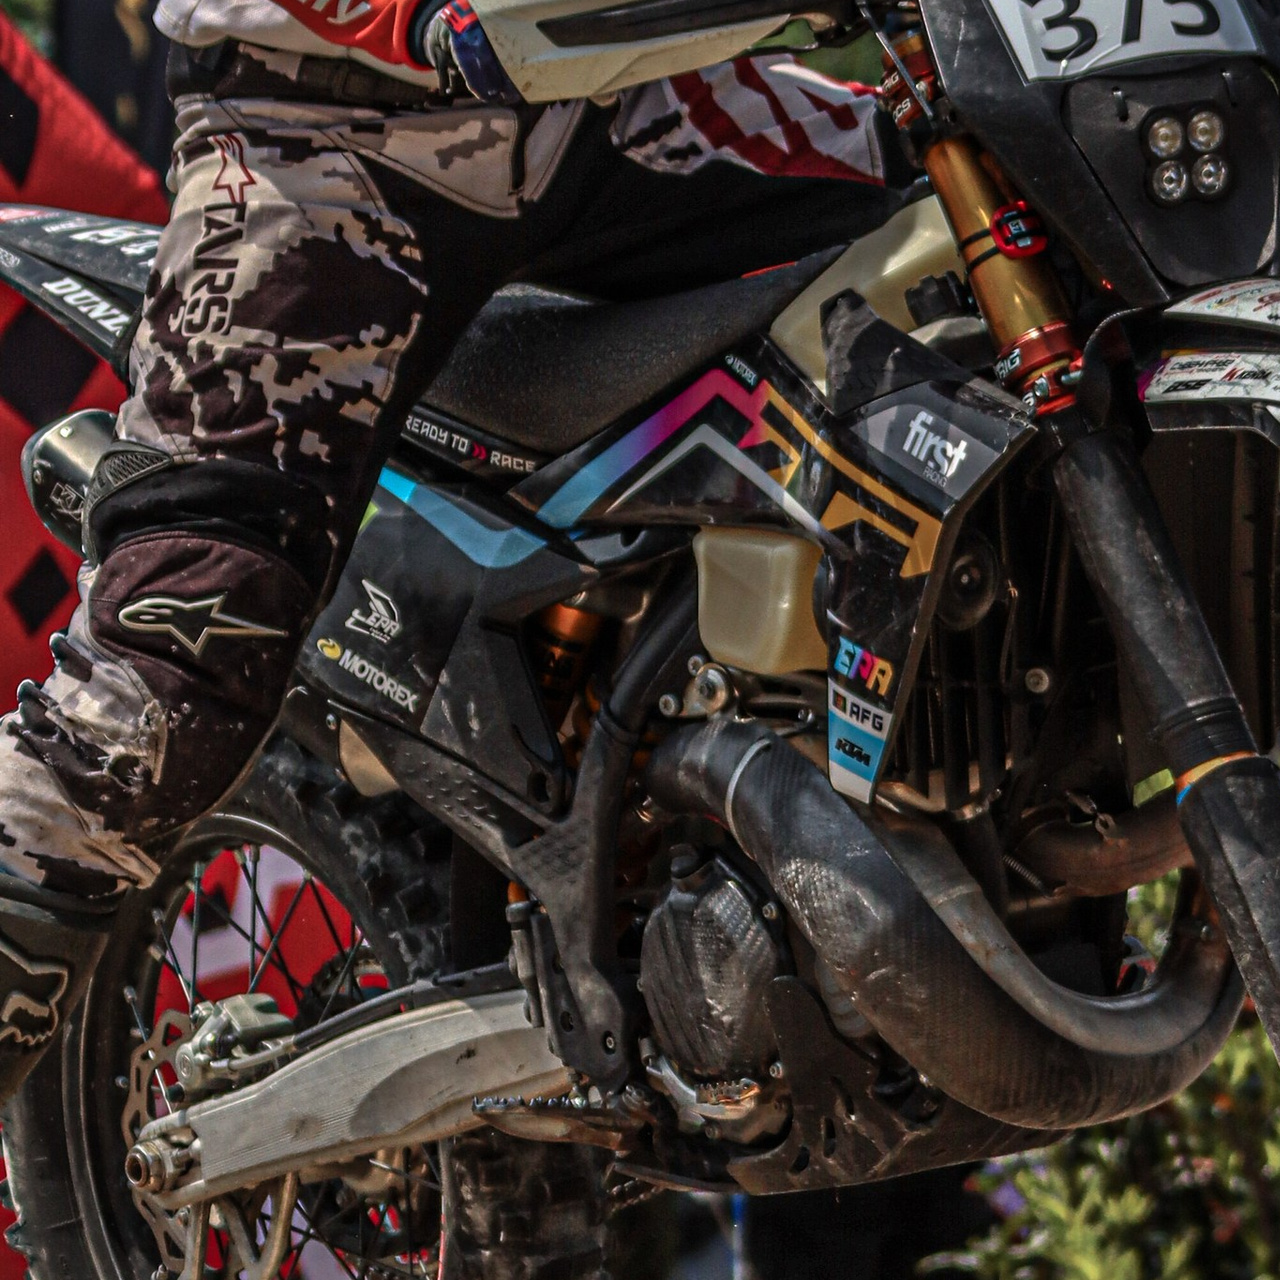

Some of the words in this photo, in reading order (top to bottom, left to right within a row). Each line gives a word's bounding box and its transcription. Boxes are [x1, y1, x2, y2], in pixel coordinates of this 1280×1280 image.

[42, 277, 131, 337] DUNL
[451, 433, 469, 453] TO
[490, 450, 536, 473] RACE
[902, 410, 968, 478] first
[922, 465, 949, 488] RACING
[338, 649, 419, 714] MOTOREX
[849, 702, 884, 733] AFG
[834, 738, 872, 768] KTM
